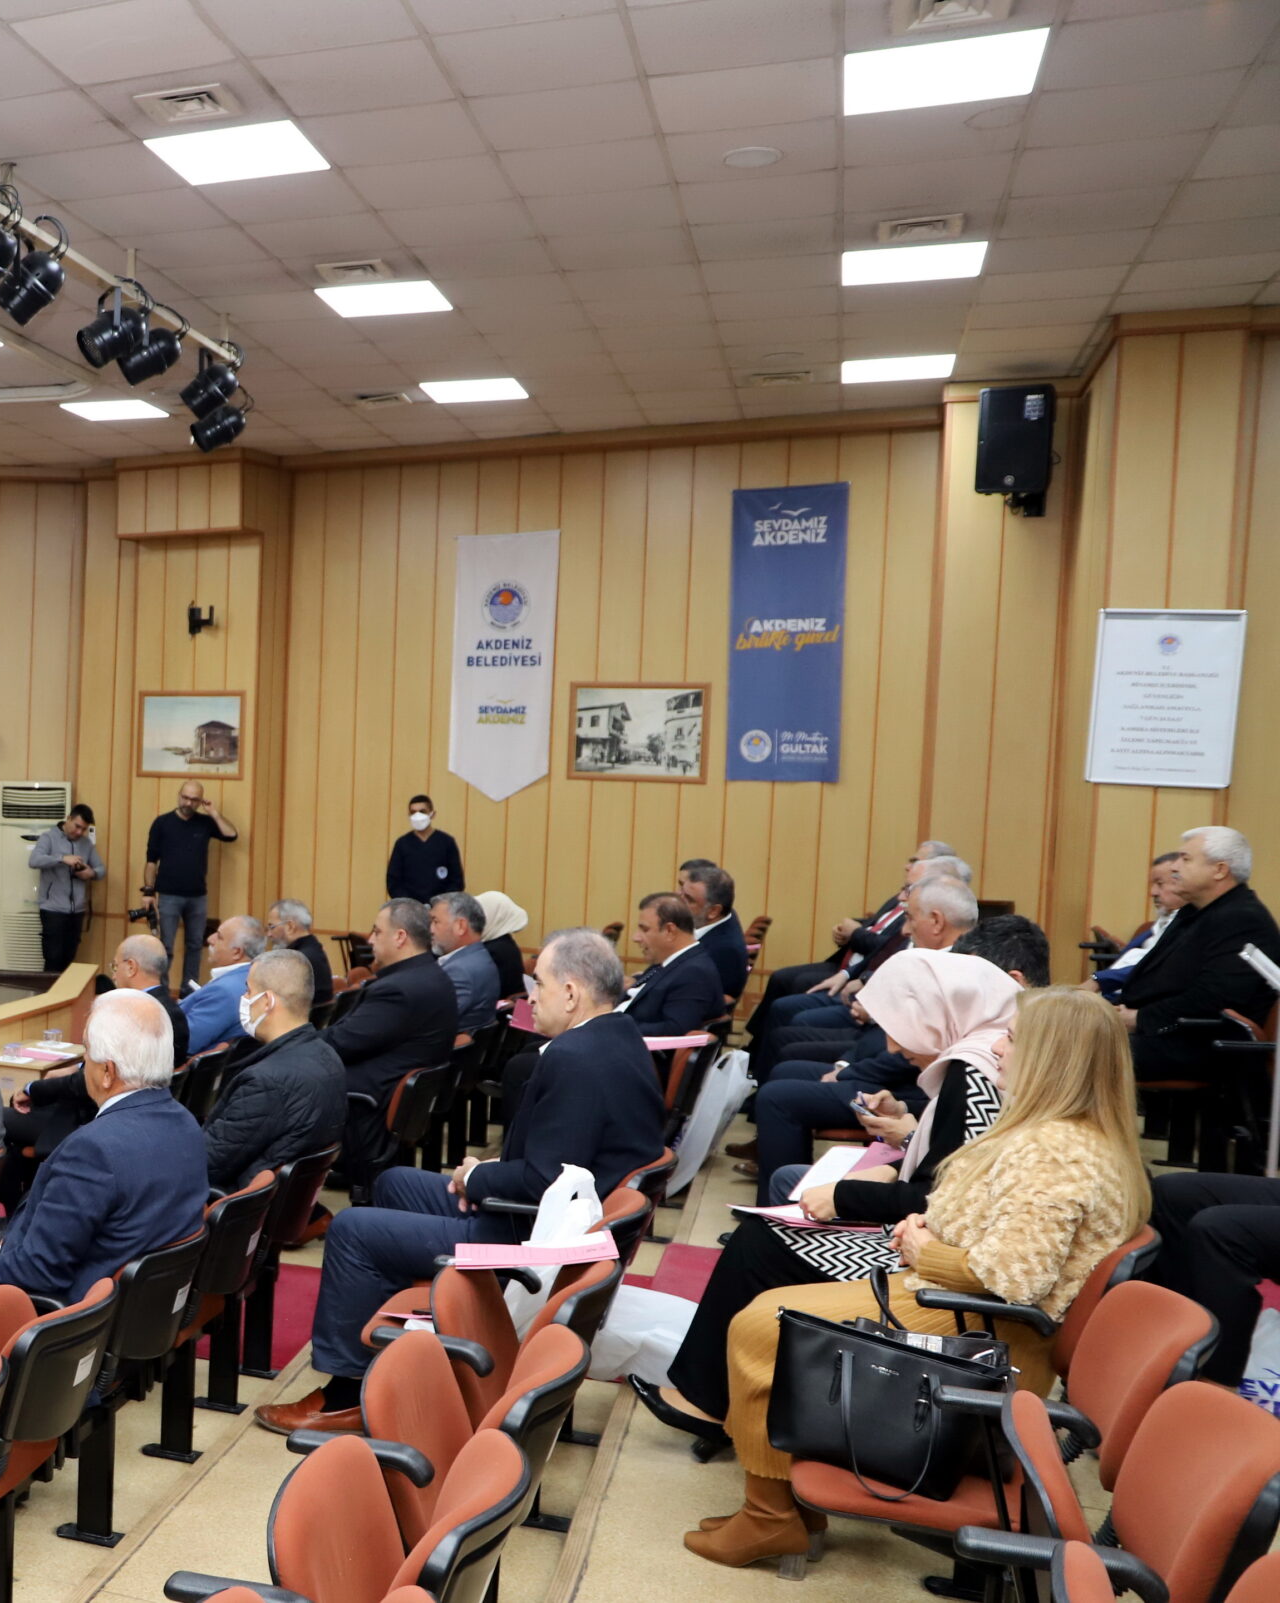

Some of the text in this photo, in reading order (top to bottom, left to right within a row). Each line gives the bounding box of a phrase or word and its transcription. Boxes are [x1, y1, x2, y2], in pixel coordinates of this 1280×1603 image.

[754, 516, 828, 532] SEVDAMIZ
[476, 636, 533, 650] AKDENİZ
[467, 652, 542, 667] BELEDİYESİ
